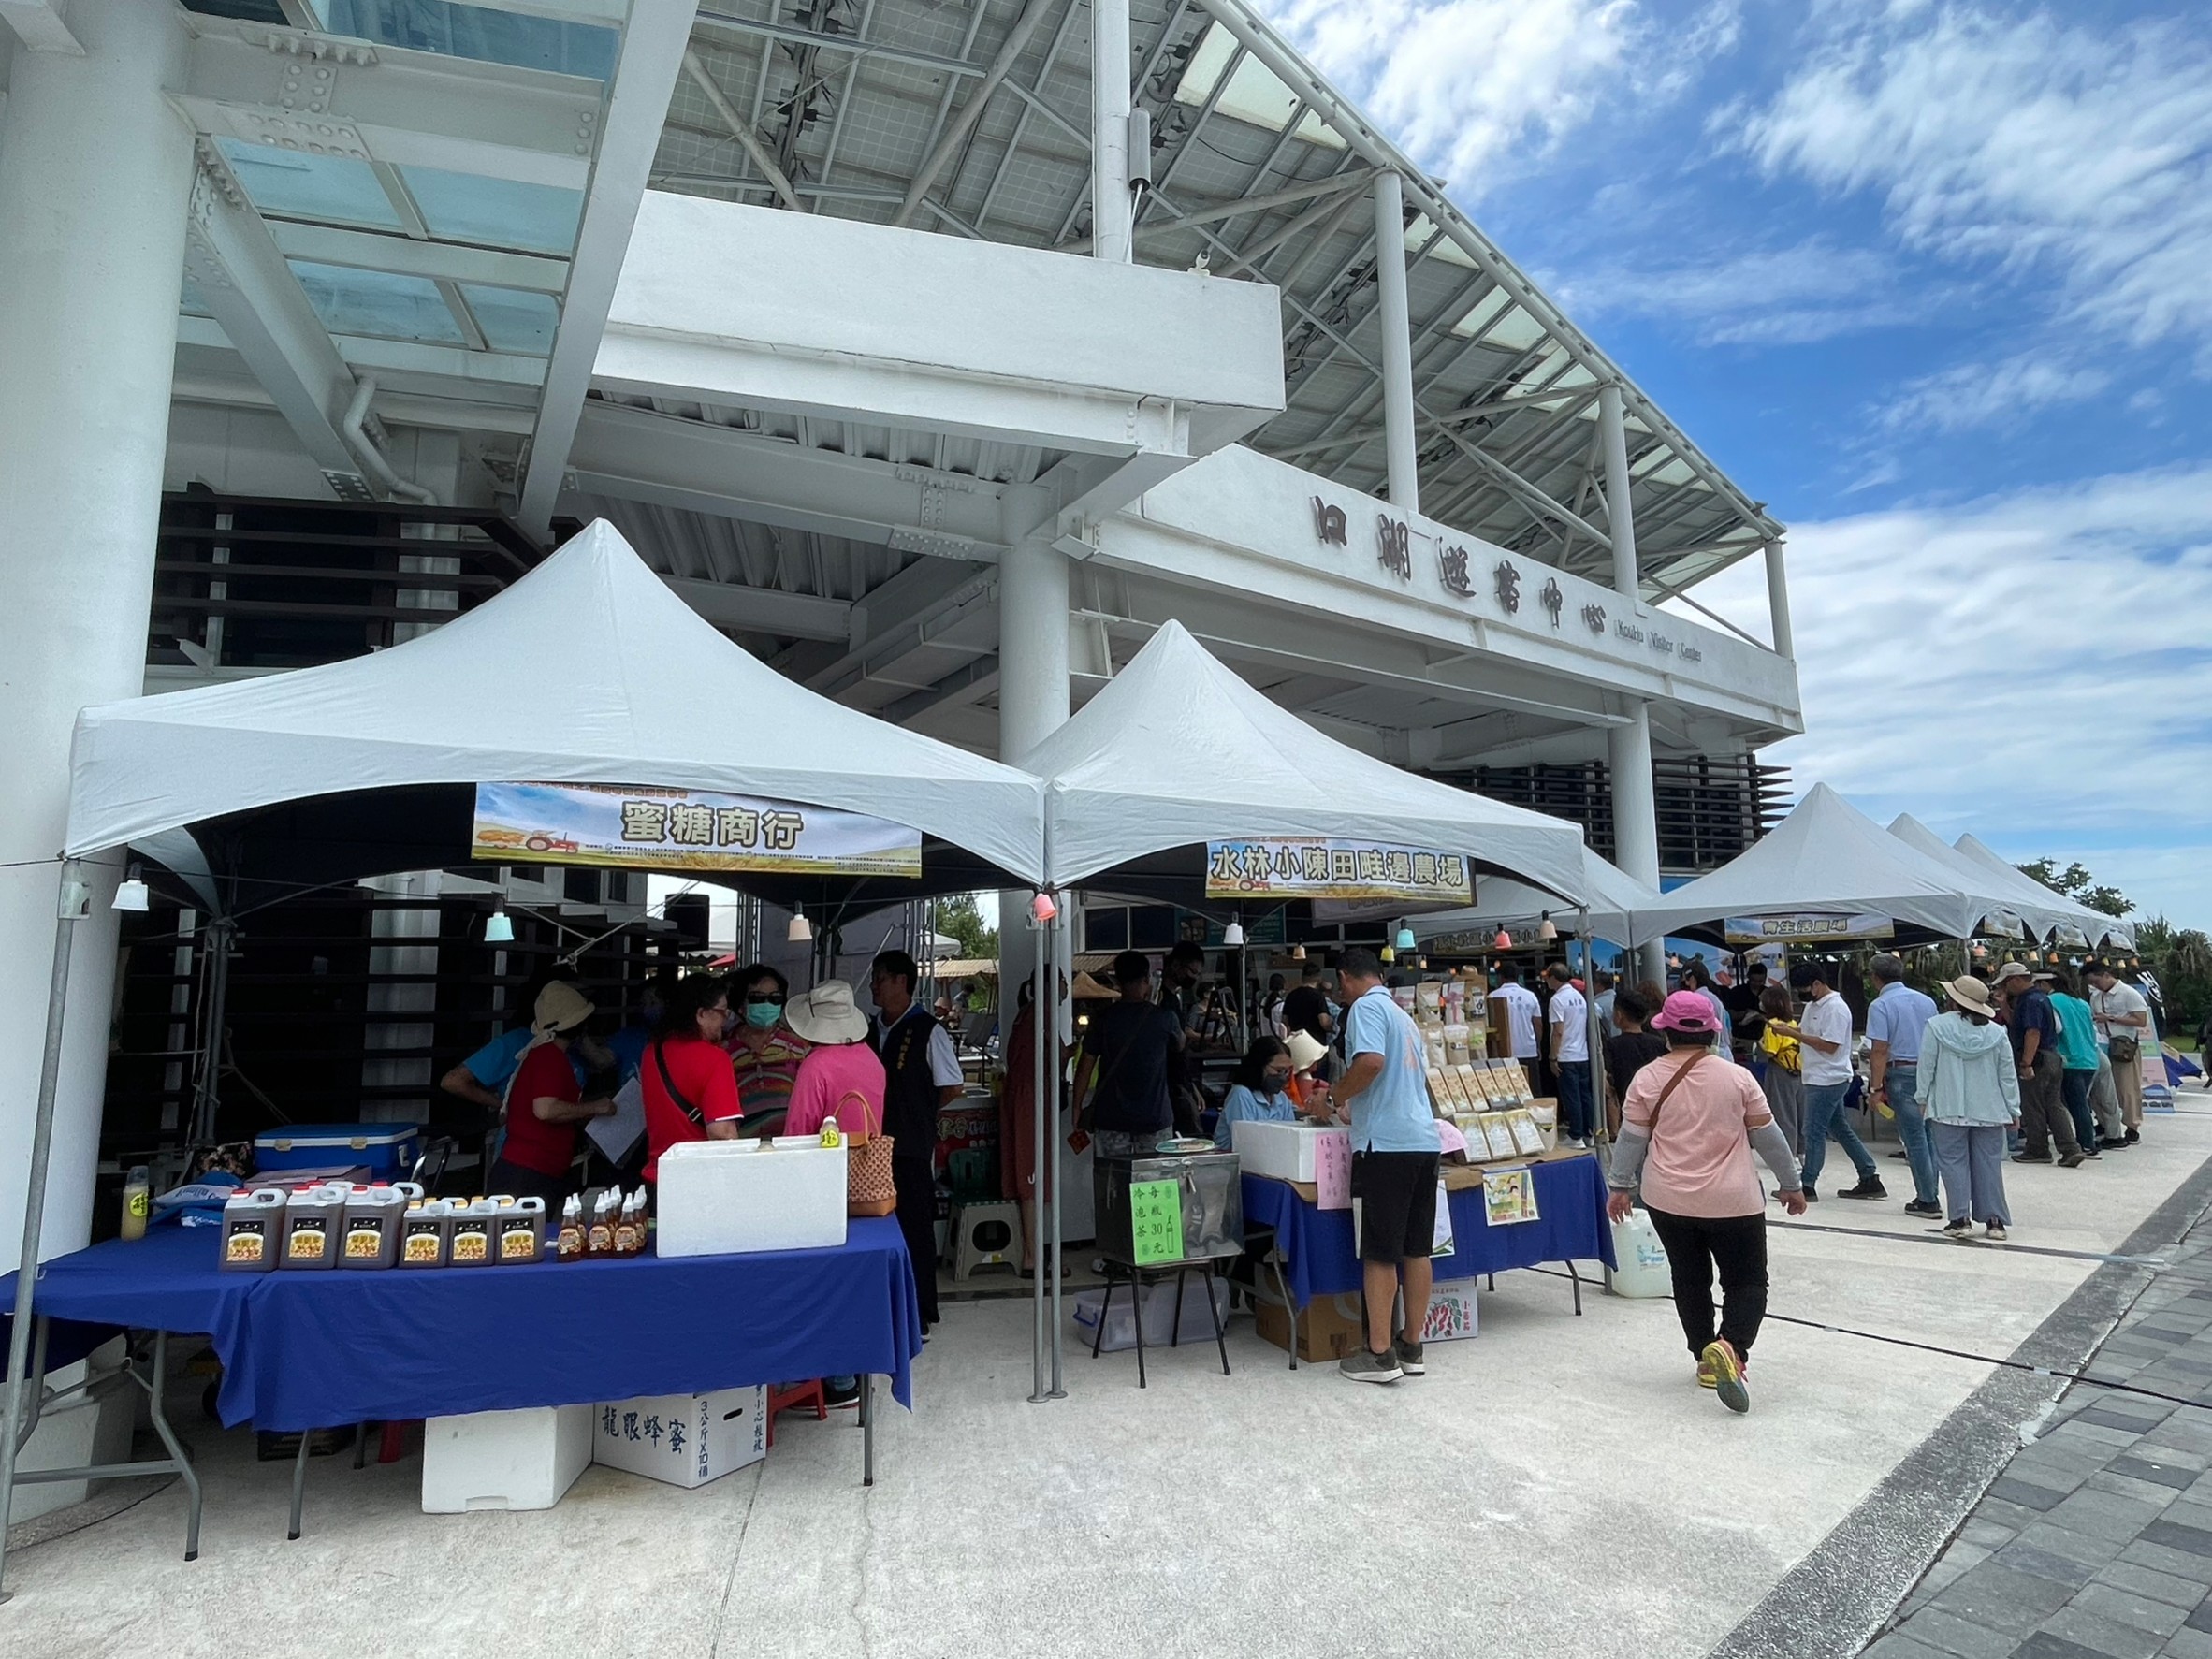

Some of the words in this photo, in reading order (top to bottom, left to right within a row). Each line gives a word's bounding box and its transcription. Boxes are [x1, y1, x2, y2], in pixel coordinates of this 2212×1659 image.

[620, 800, 805, 850] 蜜糖商行
[1211, 845, 1463, 887] 水林小陳田畦邊農場
[602, 1405, 687, 1455] 龍眼蜂蜜
